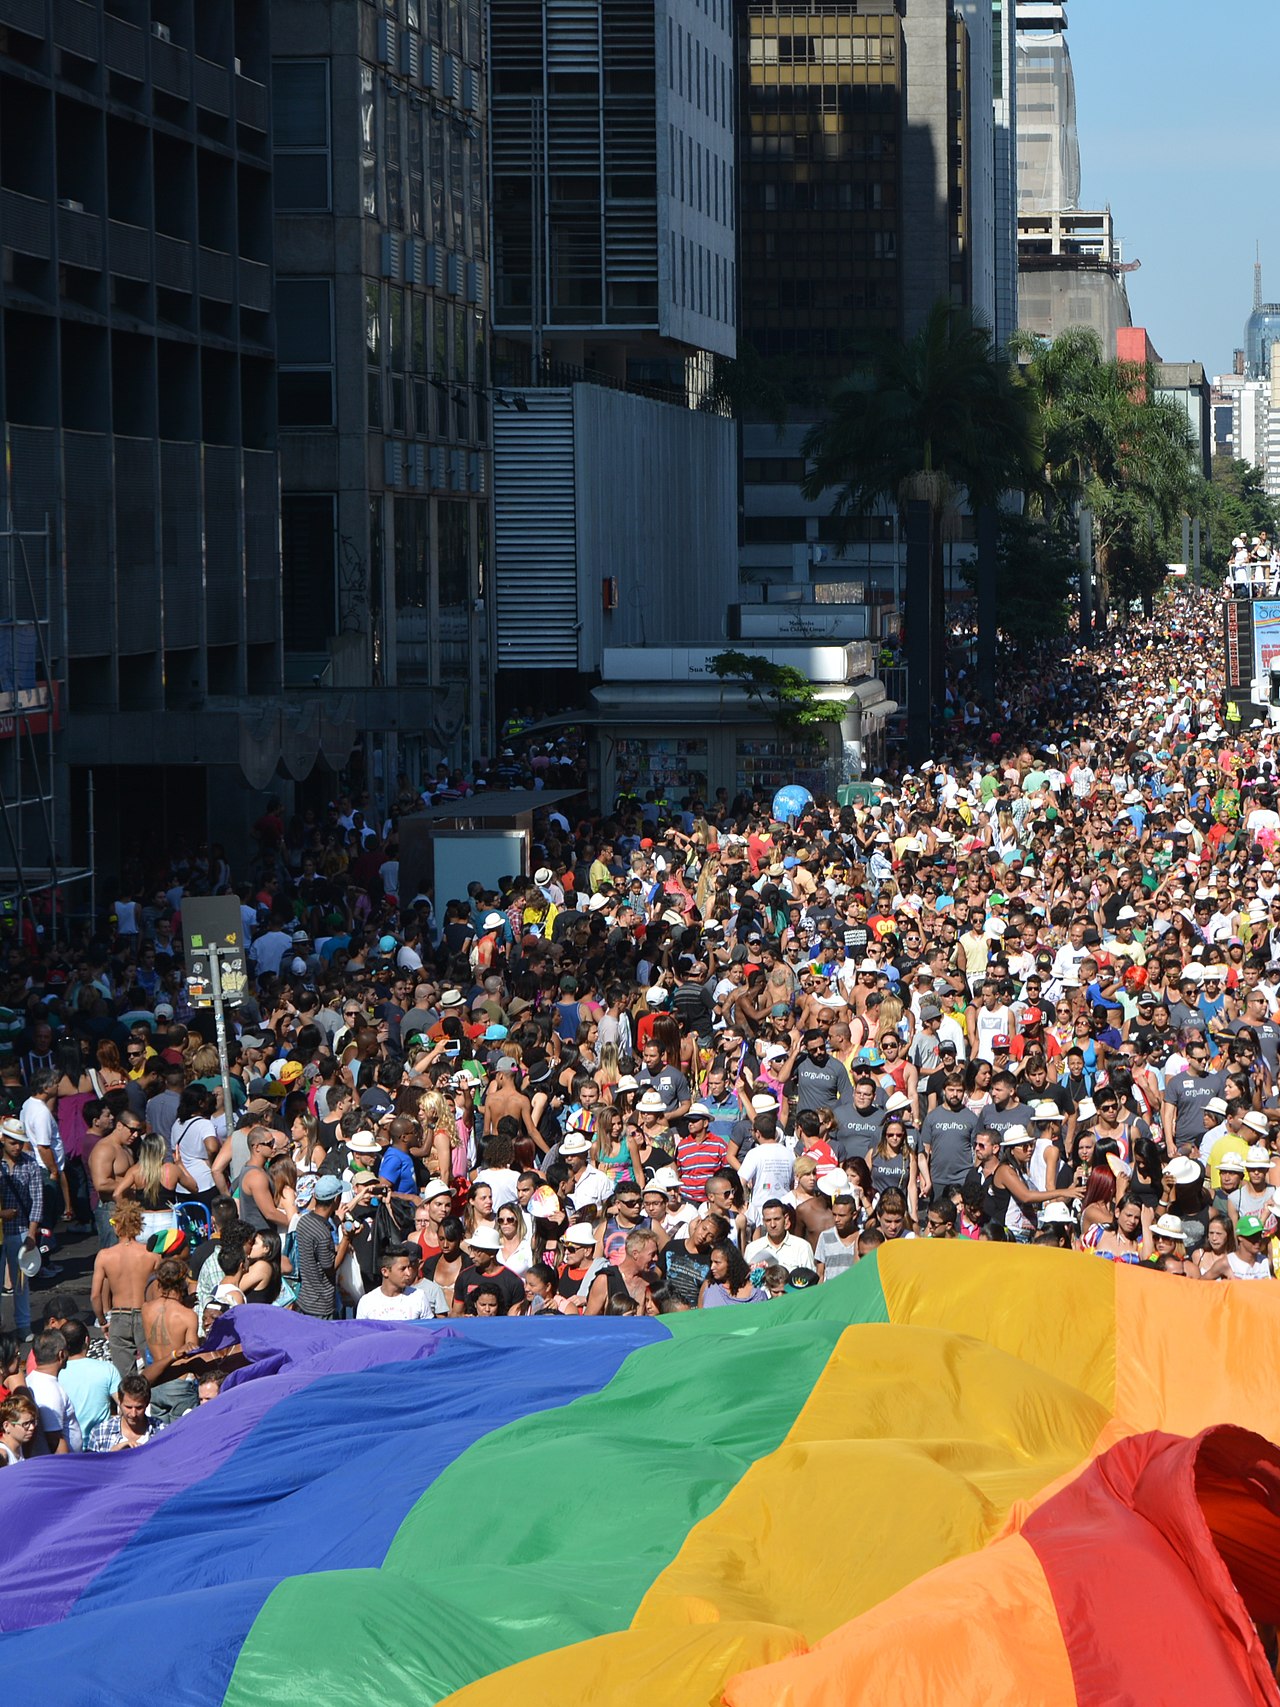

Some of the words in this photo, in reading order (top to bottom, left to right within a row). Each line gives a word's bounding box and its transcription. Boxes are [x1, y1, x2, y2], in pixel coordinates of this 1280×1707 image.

[804, 1071, 830, 1080] orgulho
[1185, 1088, 1211, 1098] orgulho
[847, 1122, 877, 1132] orgulho
[935, 1121, 964, 1131] orgulho
[990, 1122, 1014, 1131] orgulh
